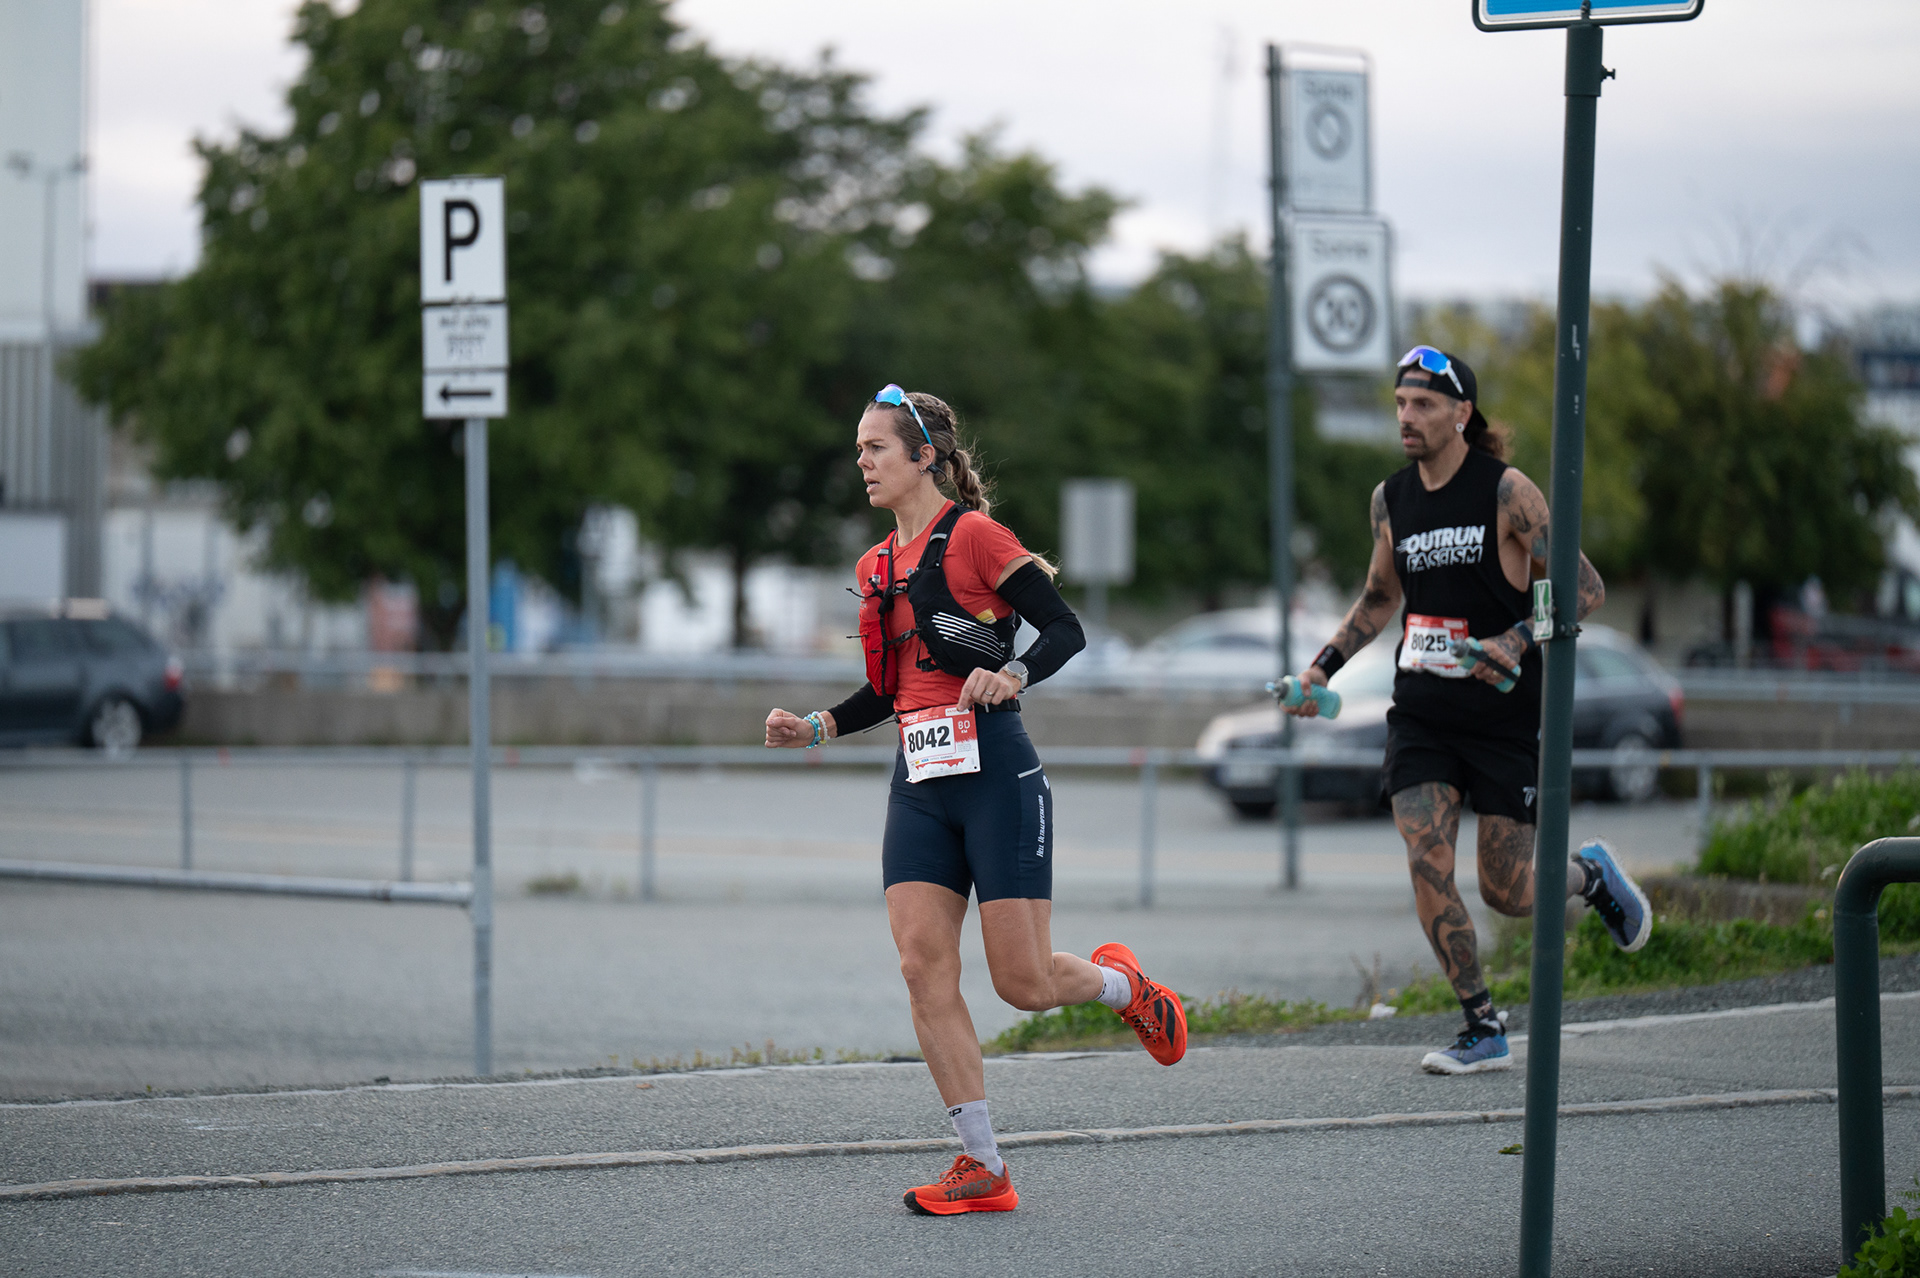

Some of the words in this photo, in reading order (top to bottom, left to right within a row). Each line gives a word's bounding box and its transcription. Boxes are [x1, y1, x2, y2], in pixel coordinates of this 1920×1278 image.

[444, 200, 481, 282] P
[1405, 524, 1486, 554] OUTRUN
[1537, 583, 1546, 621] K
[1411, 632, 1448, 653] 8025
[907, 725, 951, 754] 8042
[957, 720, 971, 730] 80
[944, 1178, 994, 1202] TERREX
